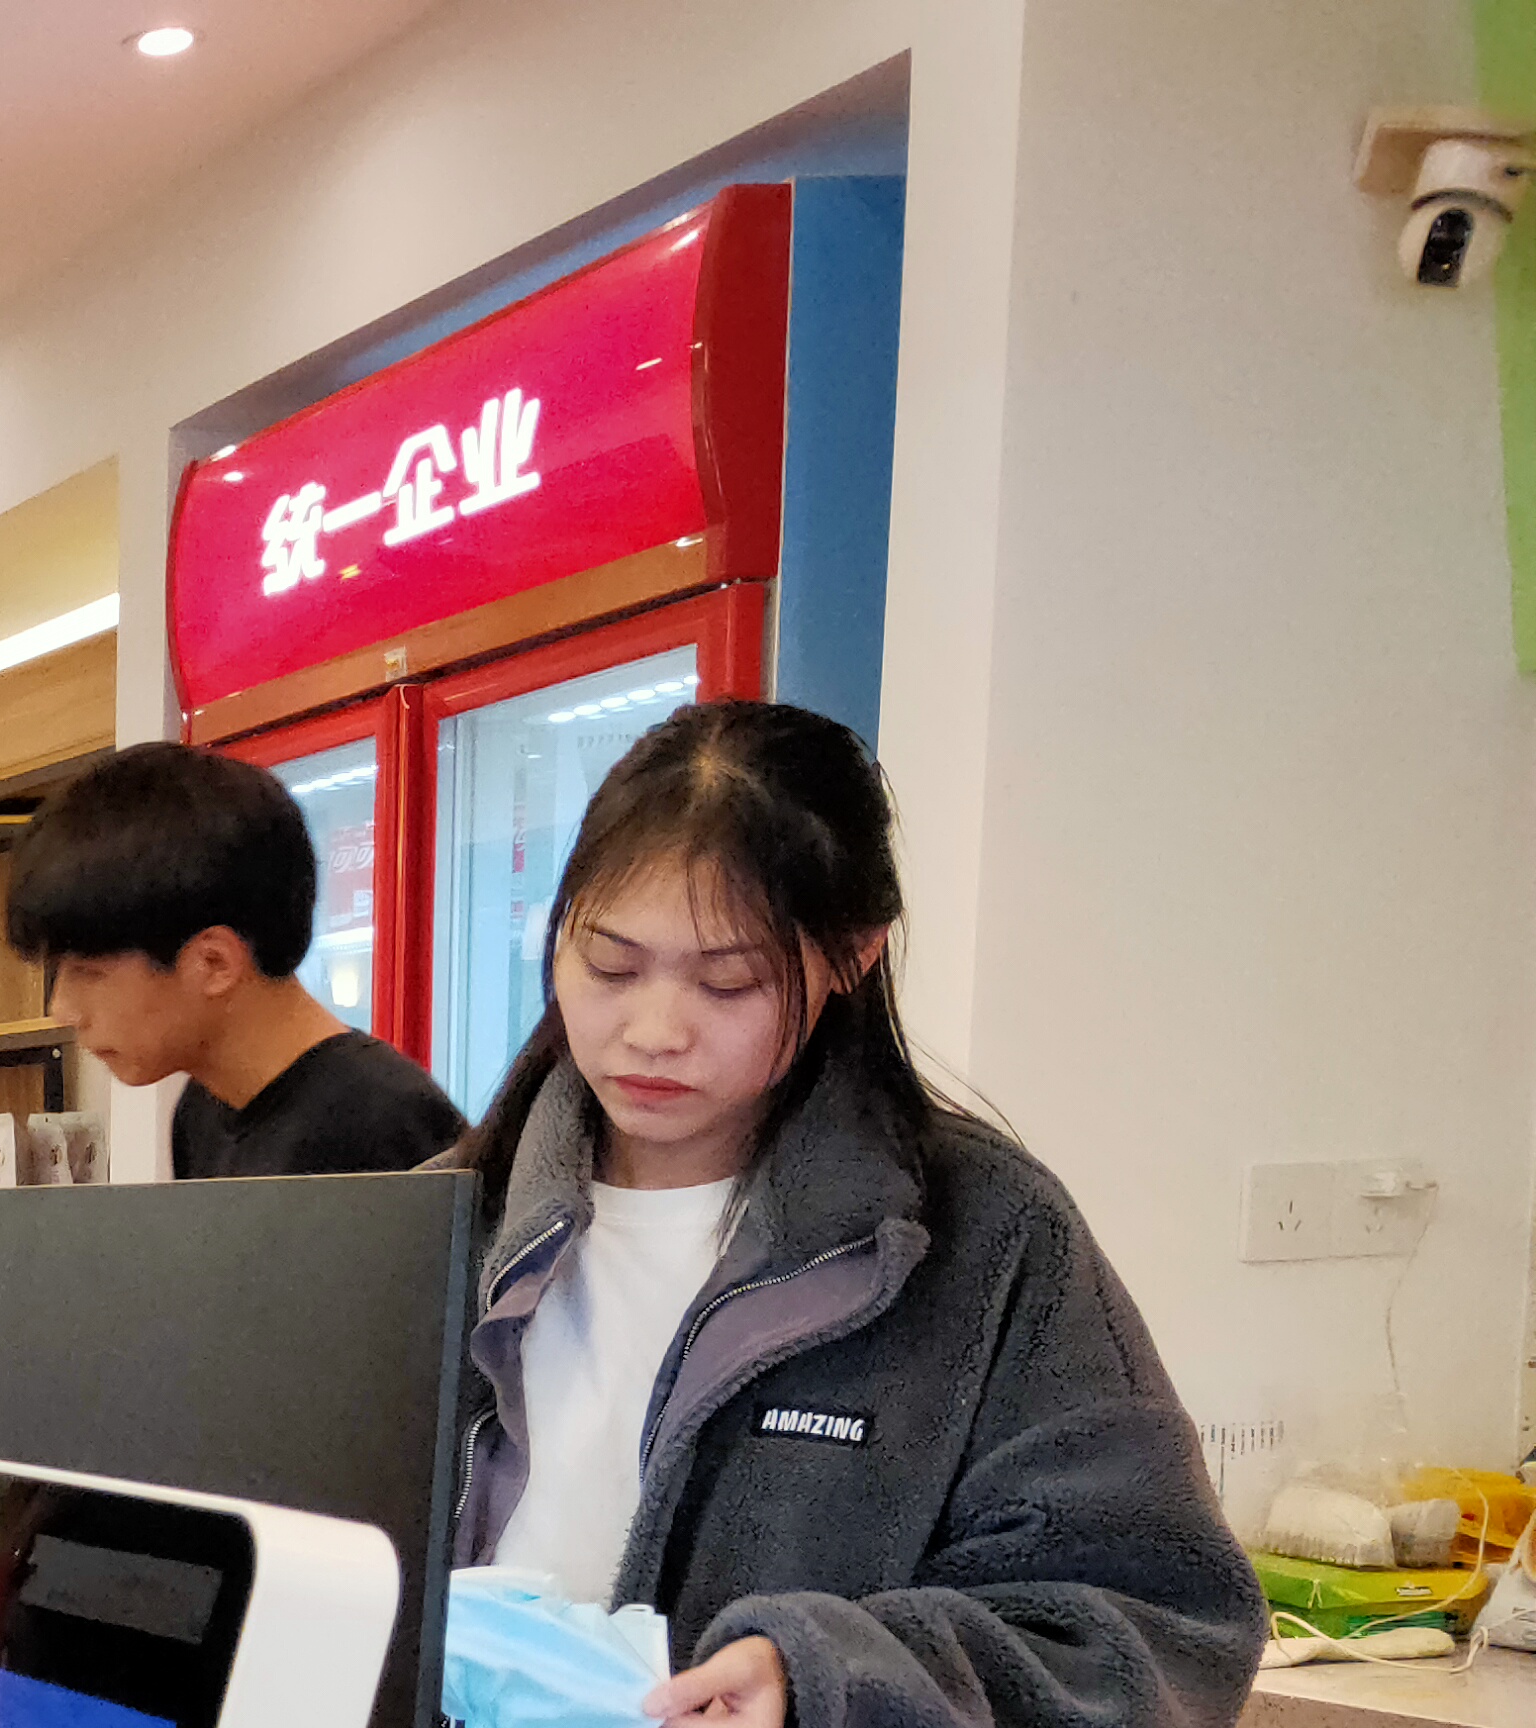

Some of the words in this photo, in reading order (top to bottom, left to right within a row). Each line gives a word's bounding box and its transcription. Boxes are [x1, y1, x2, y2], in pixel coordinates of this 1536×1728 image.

[261, 386, 540, 597] 统一企业
[761, 1408, 866, 1442] AMAZING
